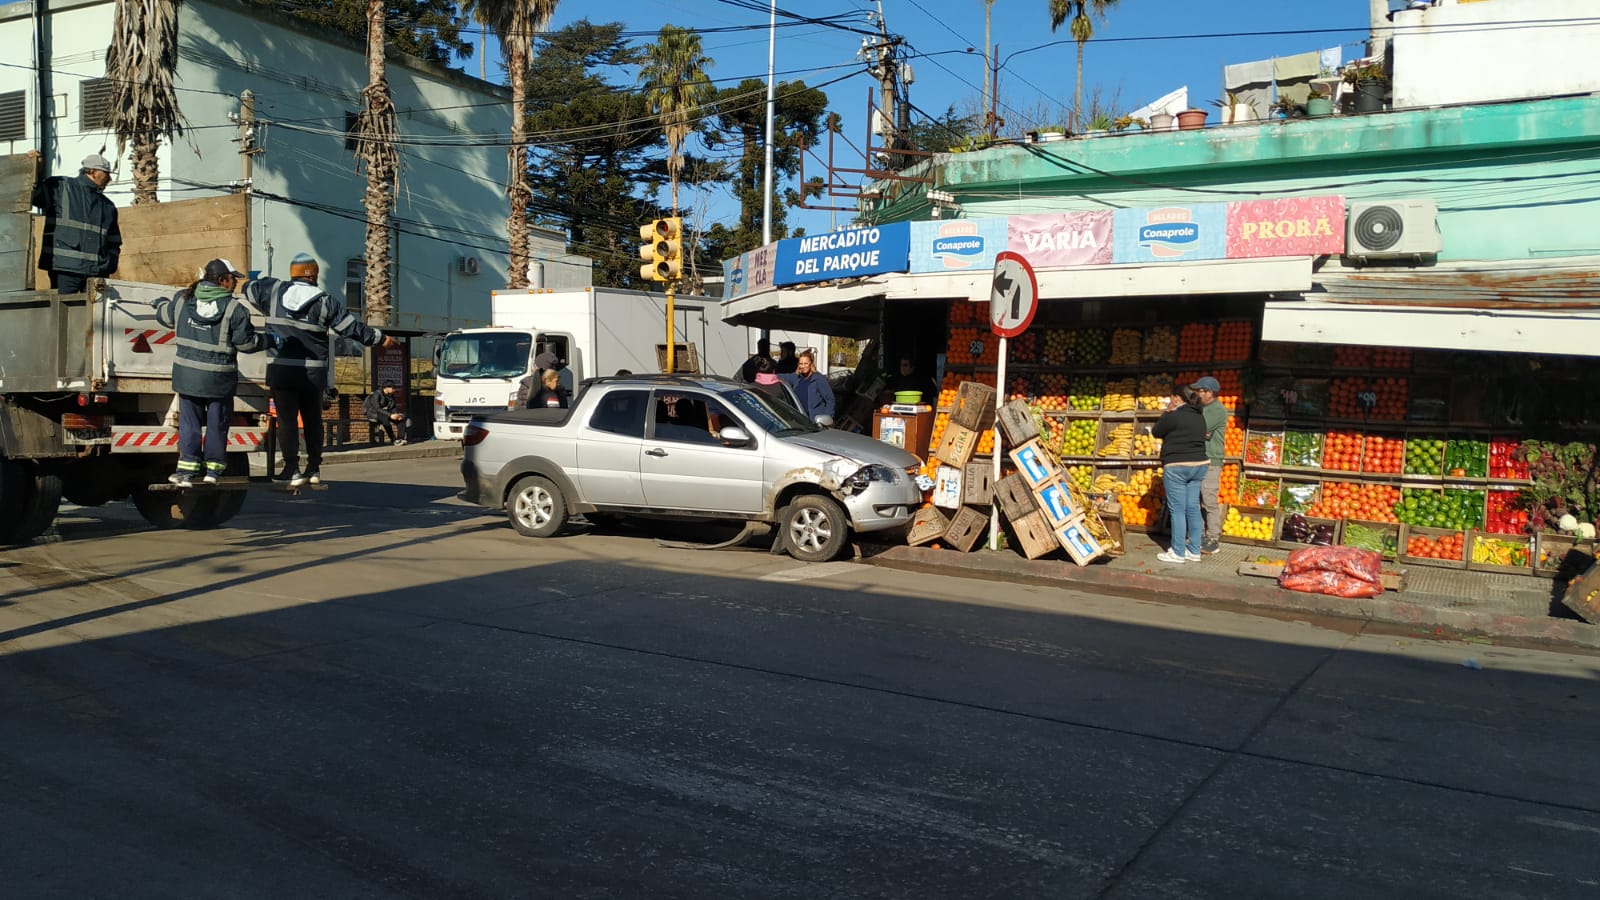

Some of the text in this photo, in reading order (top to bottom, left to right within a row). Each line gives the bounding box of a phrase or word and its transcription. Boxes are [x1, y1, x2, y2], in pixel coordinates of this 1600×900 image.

[799, 227, 880, 254] MERCADITO
[1143, 227, 1195, 239] Conaprole
[936, 240, 981, 252] Conaprole
[754, 249, 768, 268] MEZ
[795, 250, 880, 275] DEL PARQUE
[465, 396, 486, 404] JAC
